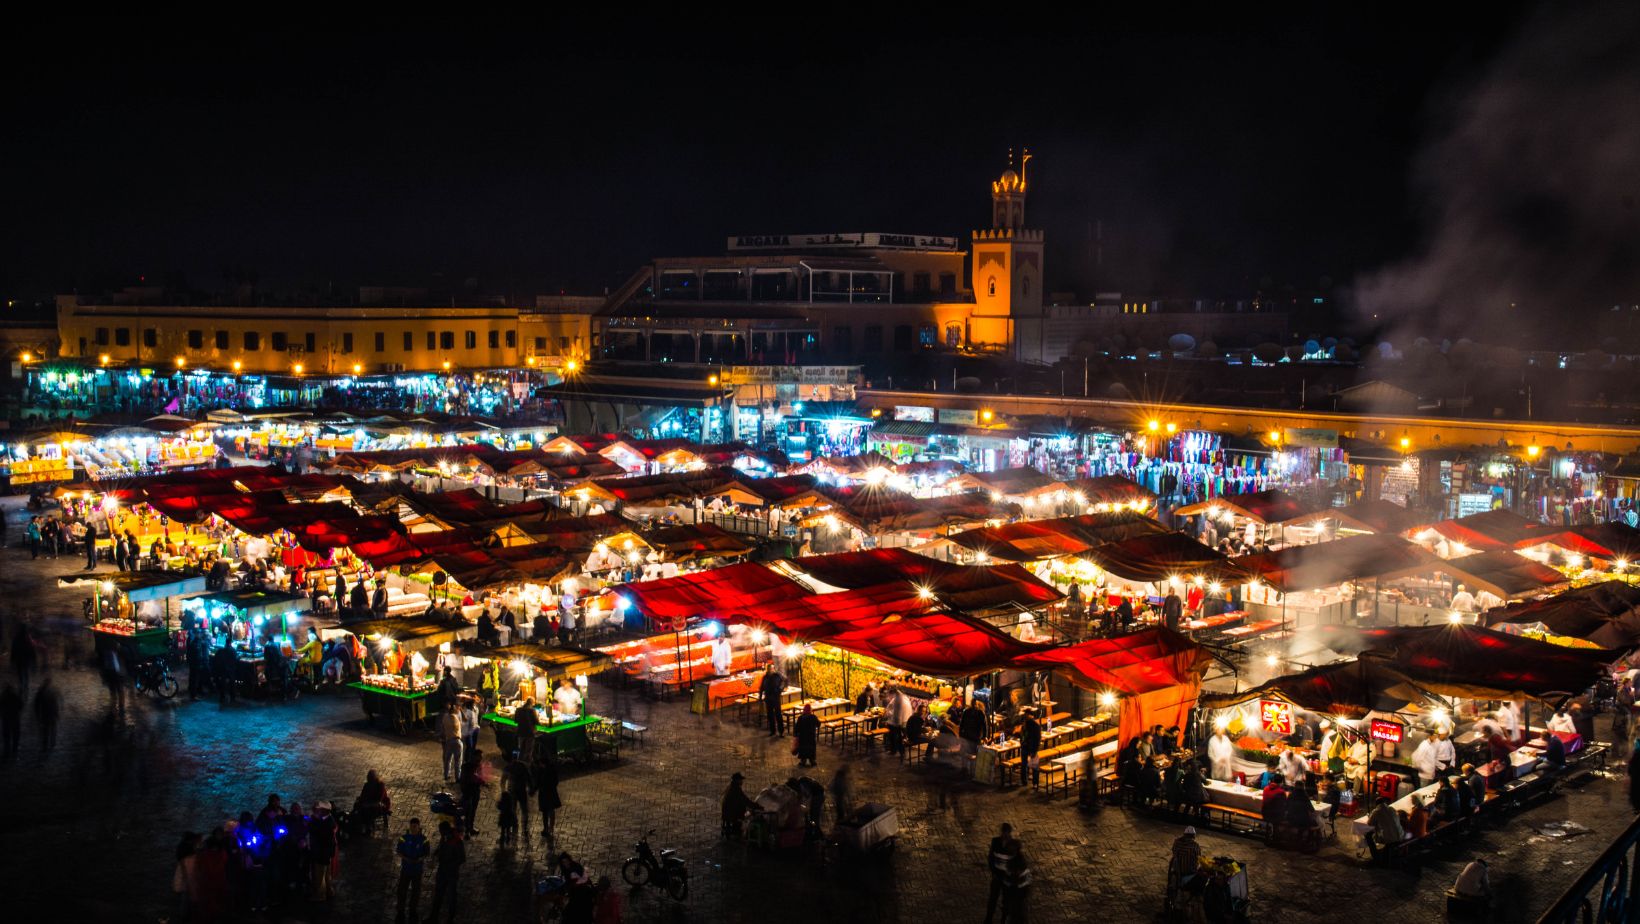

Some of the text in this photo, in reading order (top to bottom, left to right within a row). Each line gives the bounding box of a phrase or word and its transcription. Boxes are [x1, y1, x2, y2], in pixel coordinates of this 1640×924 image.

[736, 235, 790, 247] ARGANA
[879, 235, 916, 247] ARGANA
[1373, 730, 1399, 742] HASSAN
